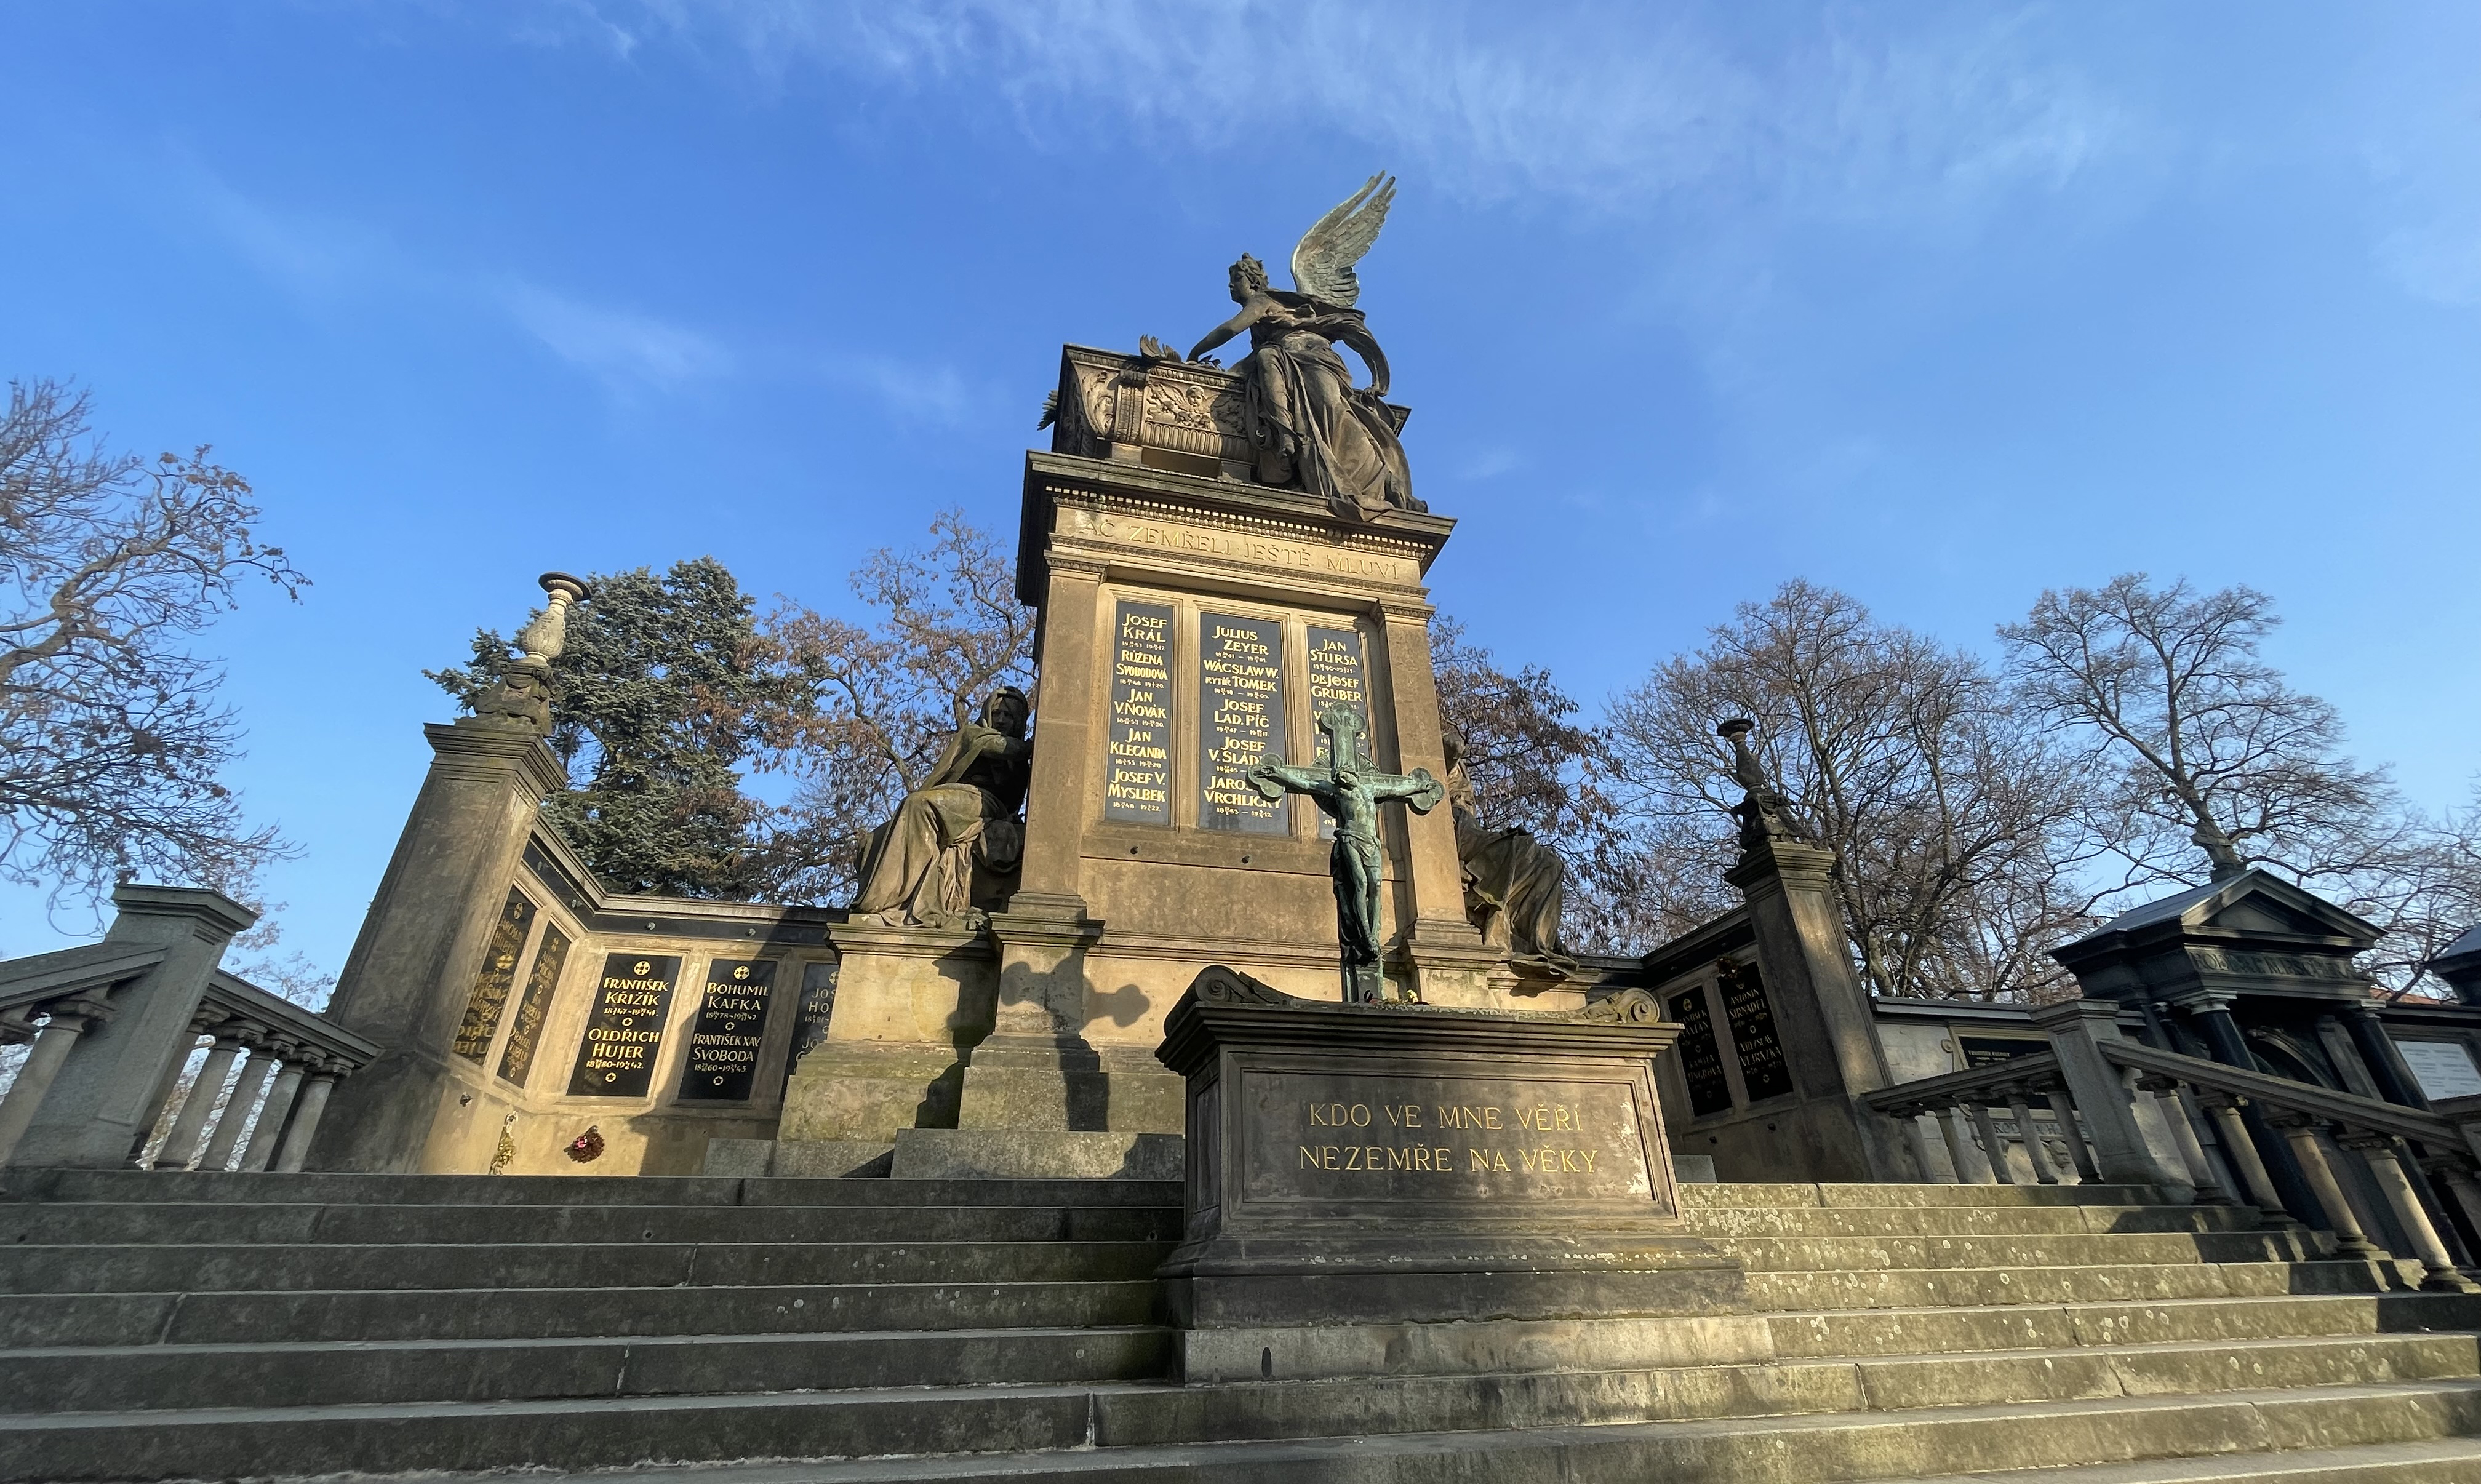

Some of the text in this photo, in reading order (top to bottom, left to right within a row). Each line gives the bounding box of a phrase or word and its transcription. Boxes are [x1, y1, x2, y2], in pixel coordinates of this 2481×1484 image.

[1079, 519, 1399, 580] AČ ZEMŘELI JEŠTĚ MLUVÍ
[1122, 613, 1167, 628] JOSEF
[1123, 626, 1166, 642] KRÁL
[1212, 626, 1258, 641] JULIUS
[1223, 639, 1269, 655] ZEYER
[1322, 639, 1346, 652] JAN
[1309, 648, 1358, 666] ŠTURSA
[1116, 663, 1168, 680] SVOBODOVÁ
[1232, 676, 1277, 692] TOMEK
[1127, 688, 1153, 703] JAN
[1311, 685, 1364, 702] GRUBER
[1220, 698, 1264, 713] JOSEF
[1214, 711, 1269, 728] LAD. PÍČ
[1125, 728, 1151, 743] JAN
[1110, 741, 1167, 759] KLECANDA
[1220, 736, 1266, 752] JOSEF
[1208, 749, 1262, 765] V. SLÁD
[1111, 768, 1166, 786] JOSEF V.
[1108, 783, 1166, 802] MYSLBEK
[603, 977, 670, 991] FRANTIŠEK
[706, 982, 769, 996] BOHUMIL
[605, 991, 660, 1006] KŘIŽÍK
[708, 995, 761, 1010] KAFKA
[808, 1001, 829, 1013] HO
[588, 1028, 660, 1043] OLDŘICH
[692, 1033, 742, 1046] FRANTIŠEK
[592, 1043, 644, 1059] HUJER
[692, 1047, 754, 1062] SVOBODA
[1309, 1103, 1584, 1132] KDO VE MNE VĚŘÍ
[1299, 1144, 1599, 1173] NEZEMŘE NA VĚKY
